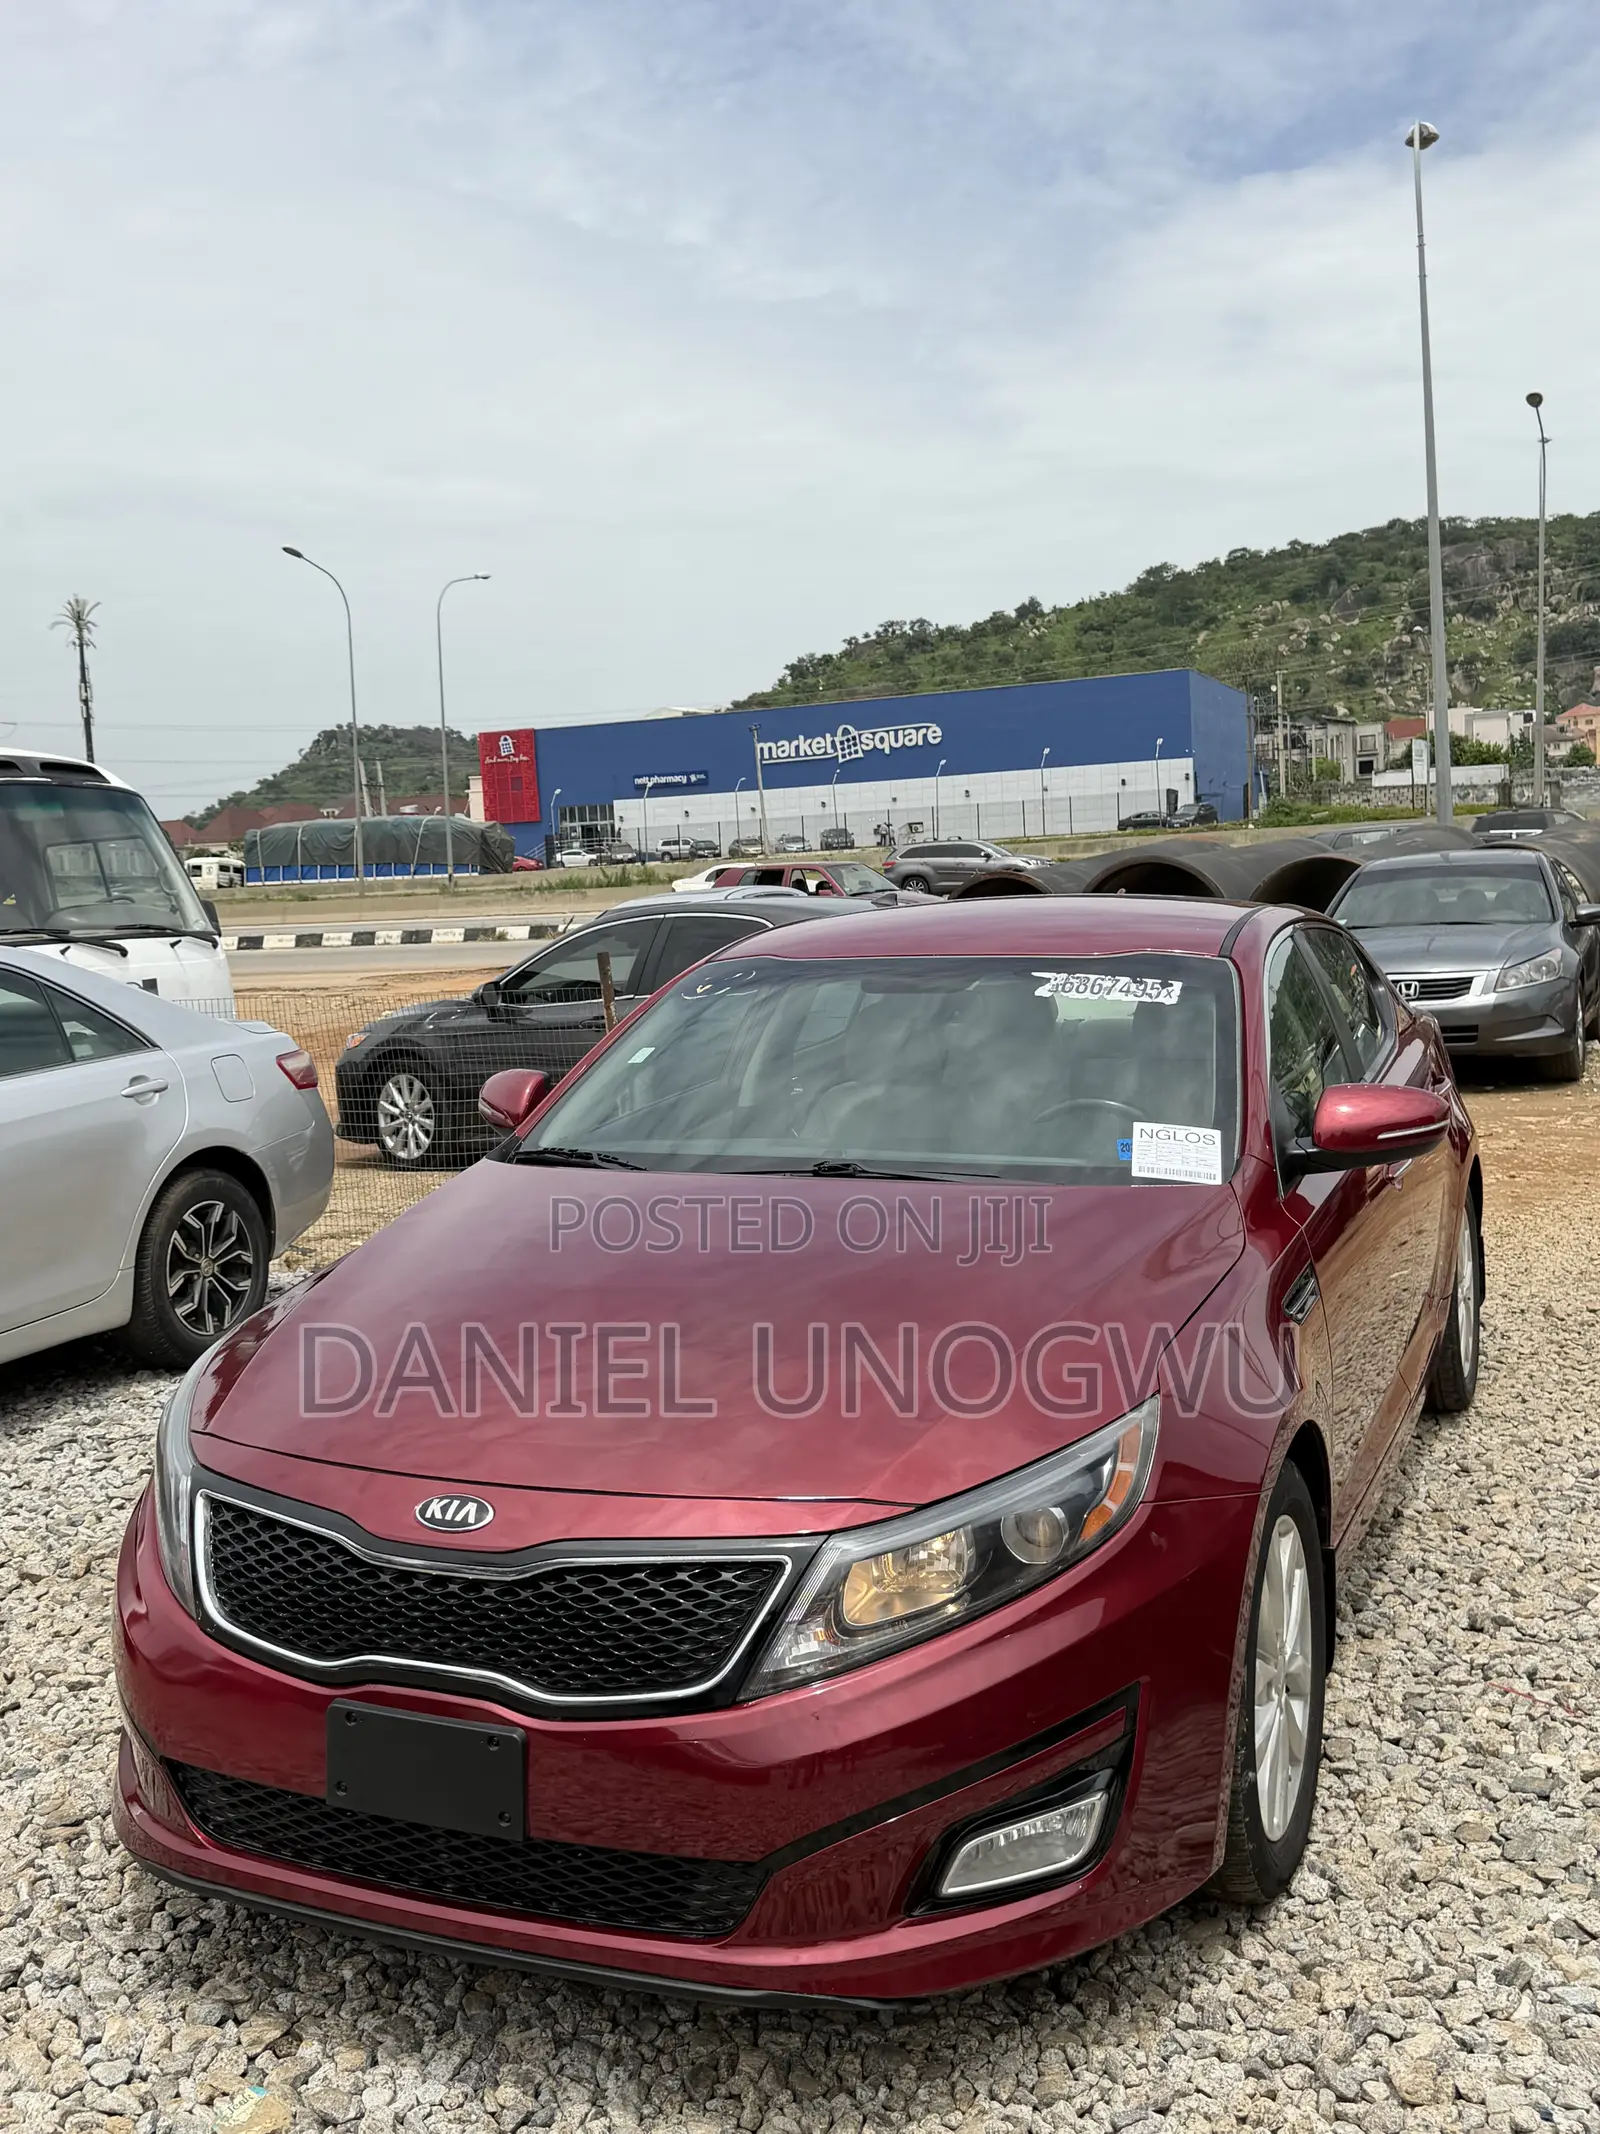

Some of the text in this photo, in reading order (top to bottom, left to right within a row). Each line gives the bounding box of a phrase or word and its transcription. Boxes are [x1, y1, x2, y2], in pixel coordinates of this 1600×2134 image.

[757, 726, 943, 760] market square
[649, 774, 687, 785] pharmacy
[1140, 1128, 1216, 1146] NGLOS
[425, 1498, 478, 1524] KIA
